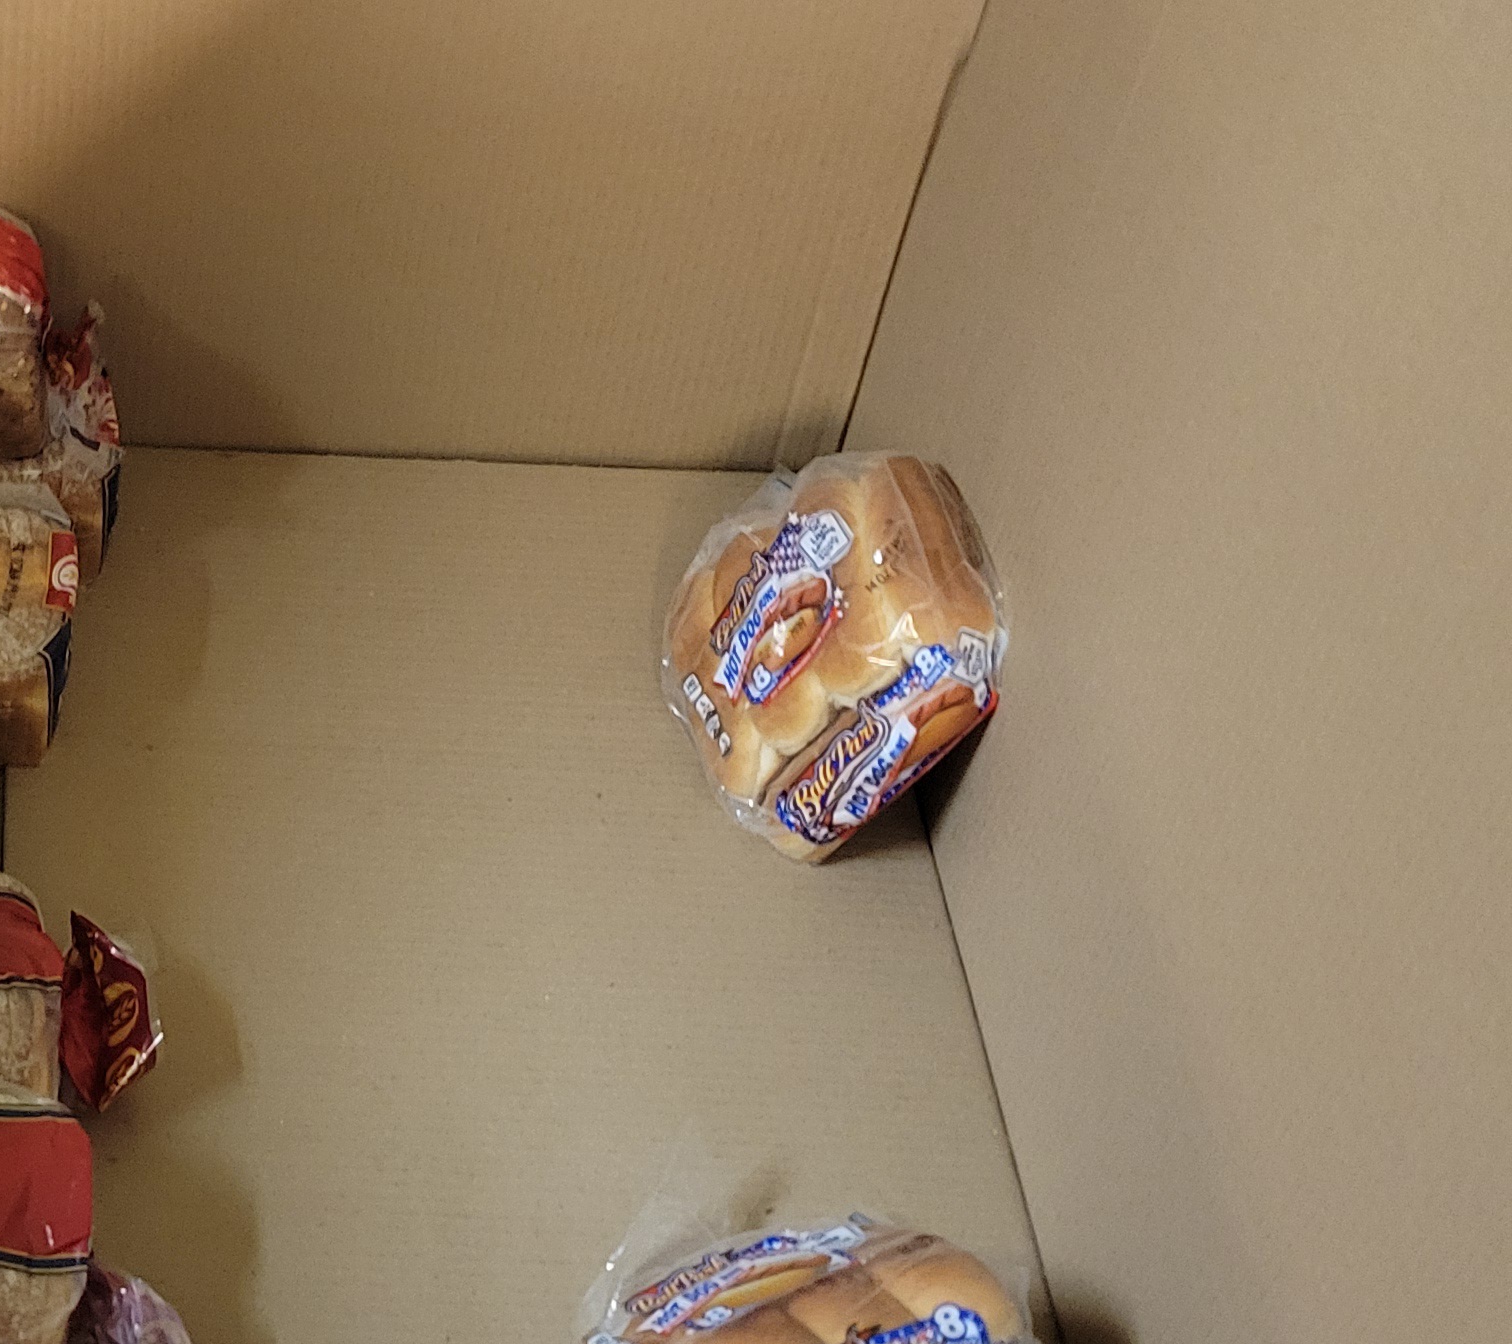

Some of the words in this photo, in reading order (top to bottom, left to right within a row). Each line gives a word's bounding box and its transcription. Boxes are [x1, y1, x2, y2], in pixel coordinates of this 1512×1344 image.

[722, 651, 747, 687] HOT
[738, 613, 762, 650] DOG
[912, 647, 938, 675] 8
[752, 664, 773, 691] 8
[792, 762, 837, 819] Ball
[831, 716, 879, 770] Park
[844, 786, 873, 819] HOT
[934, 1303, 965, 1340] 8
